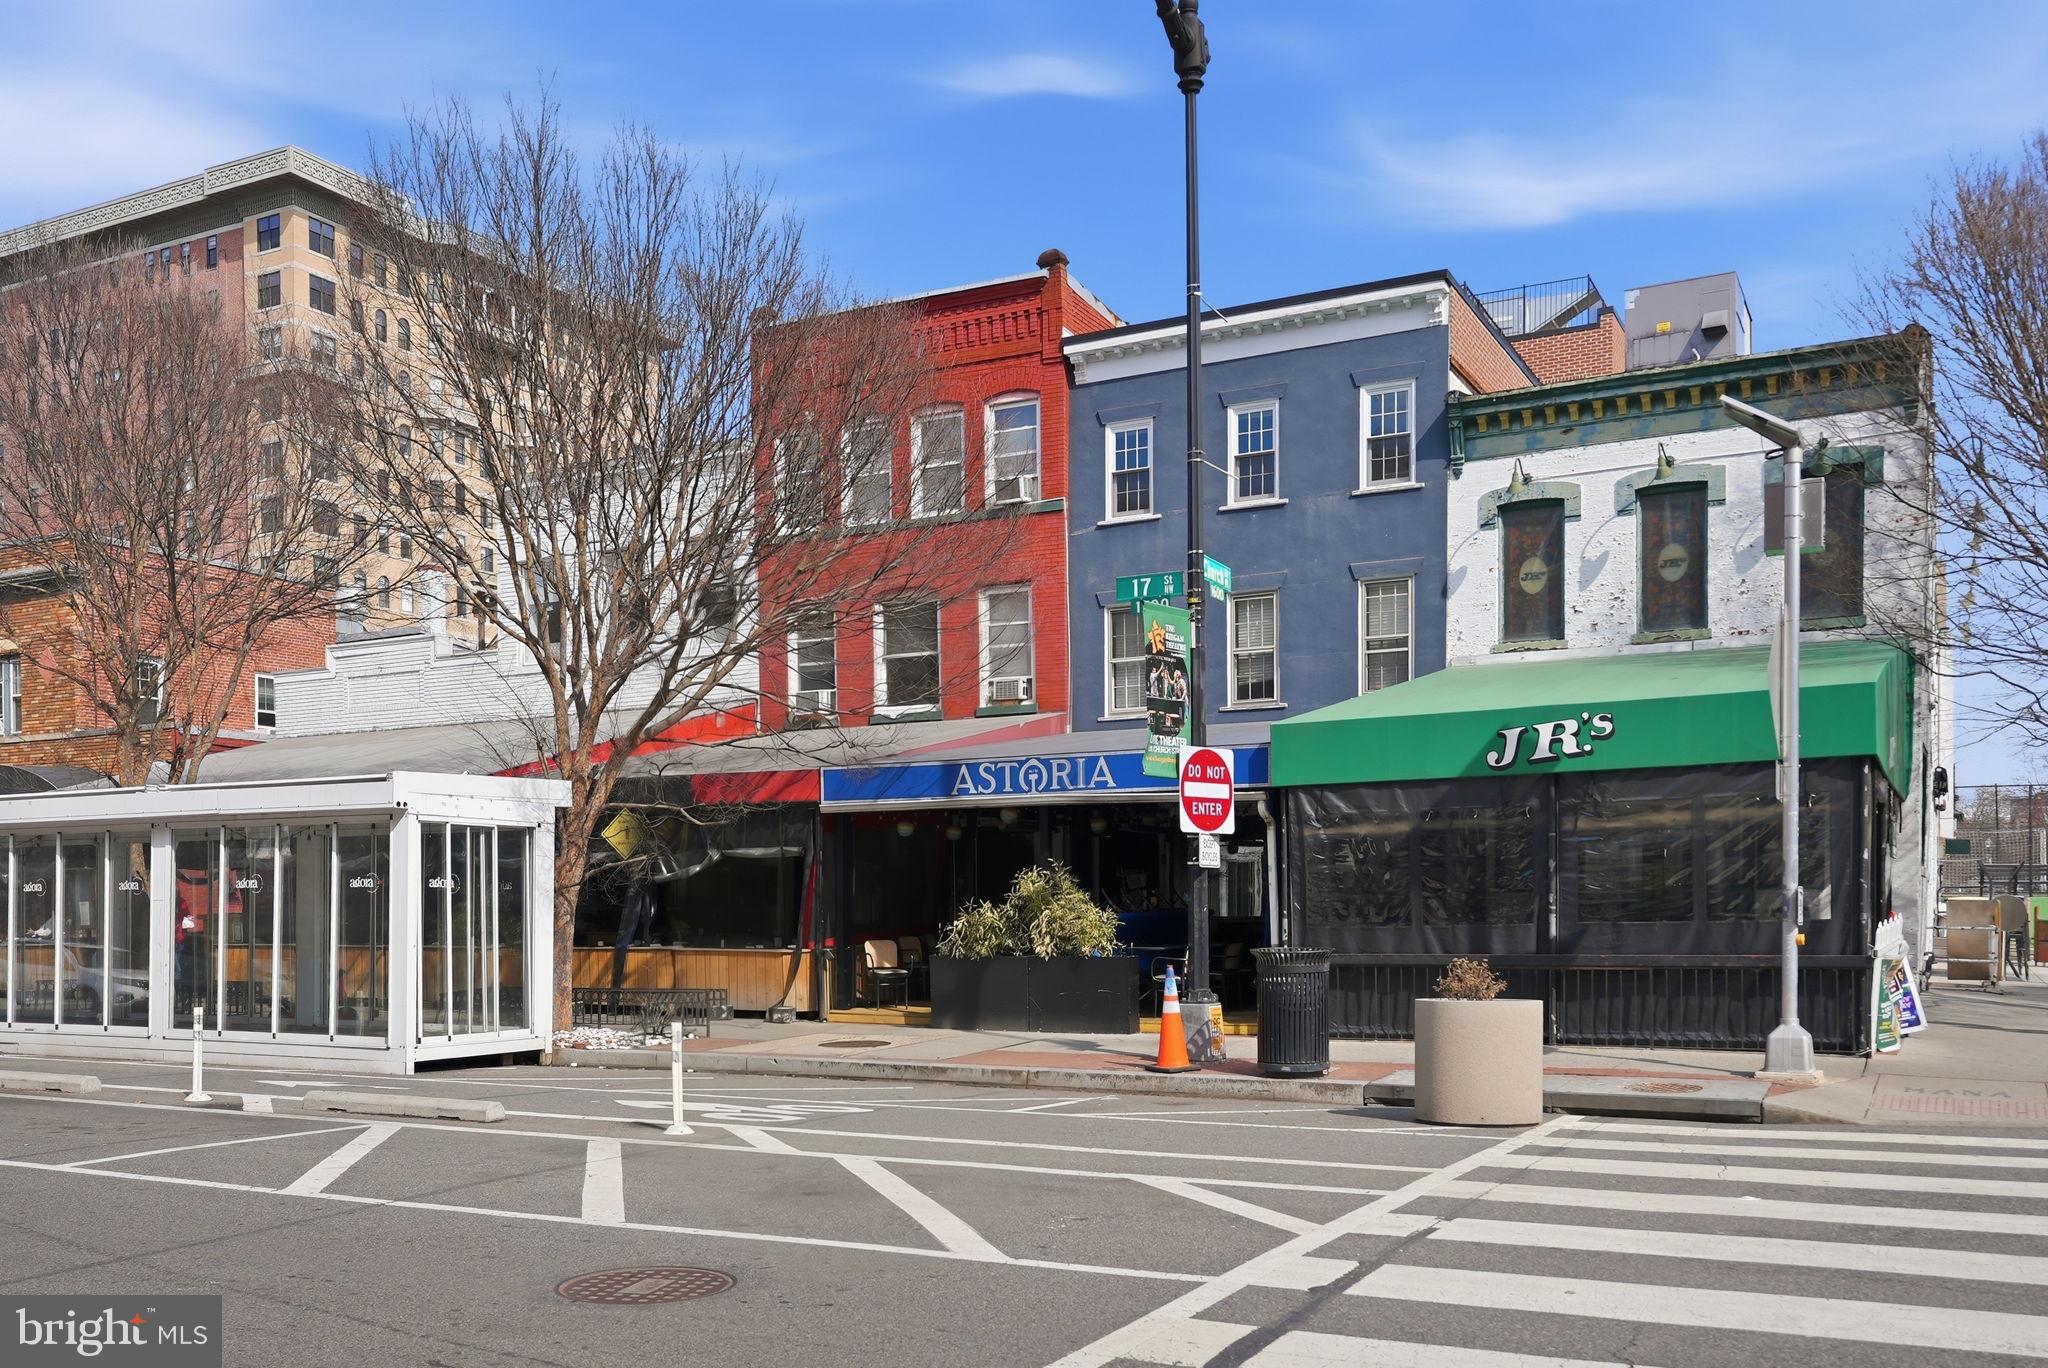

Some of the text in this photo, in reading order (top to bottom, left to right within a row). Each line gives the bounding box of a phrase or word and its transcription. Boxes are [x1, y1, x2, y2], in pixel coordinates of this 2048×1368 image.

[1132, 575, 1173, 597] 17 St
[1164, 585, 1174, 594] NW
[951, 756, 1117, 795] ASTORIA
[1188, 764, 1225, 780] DO NOT
[1192, 802, 1222, 816] ENTER
